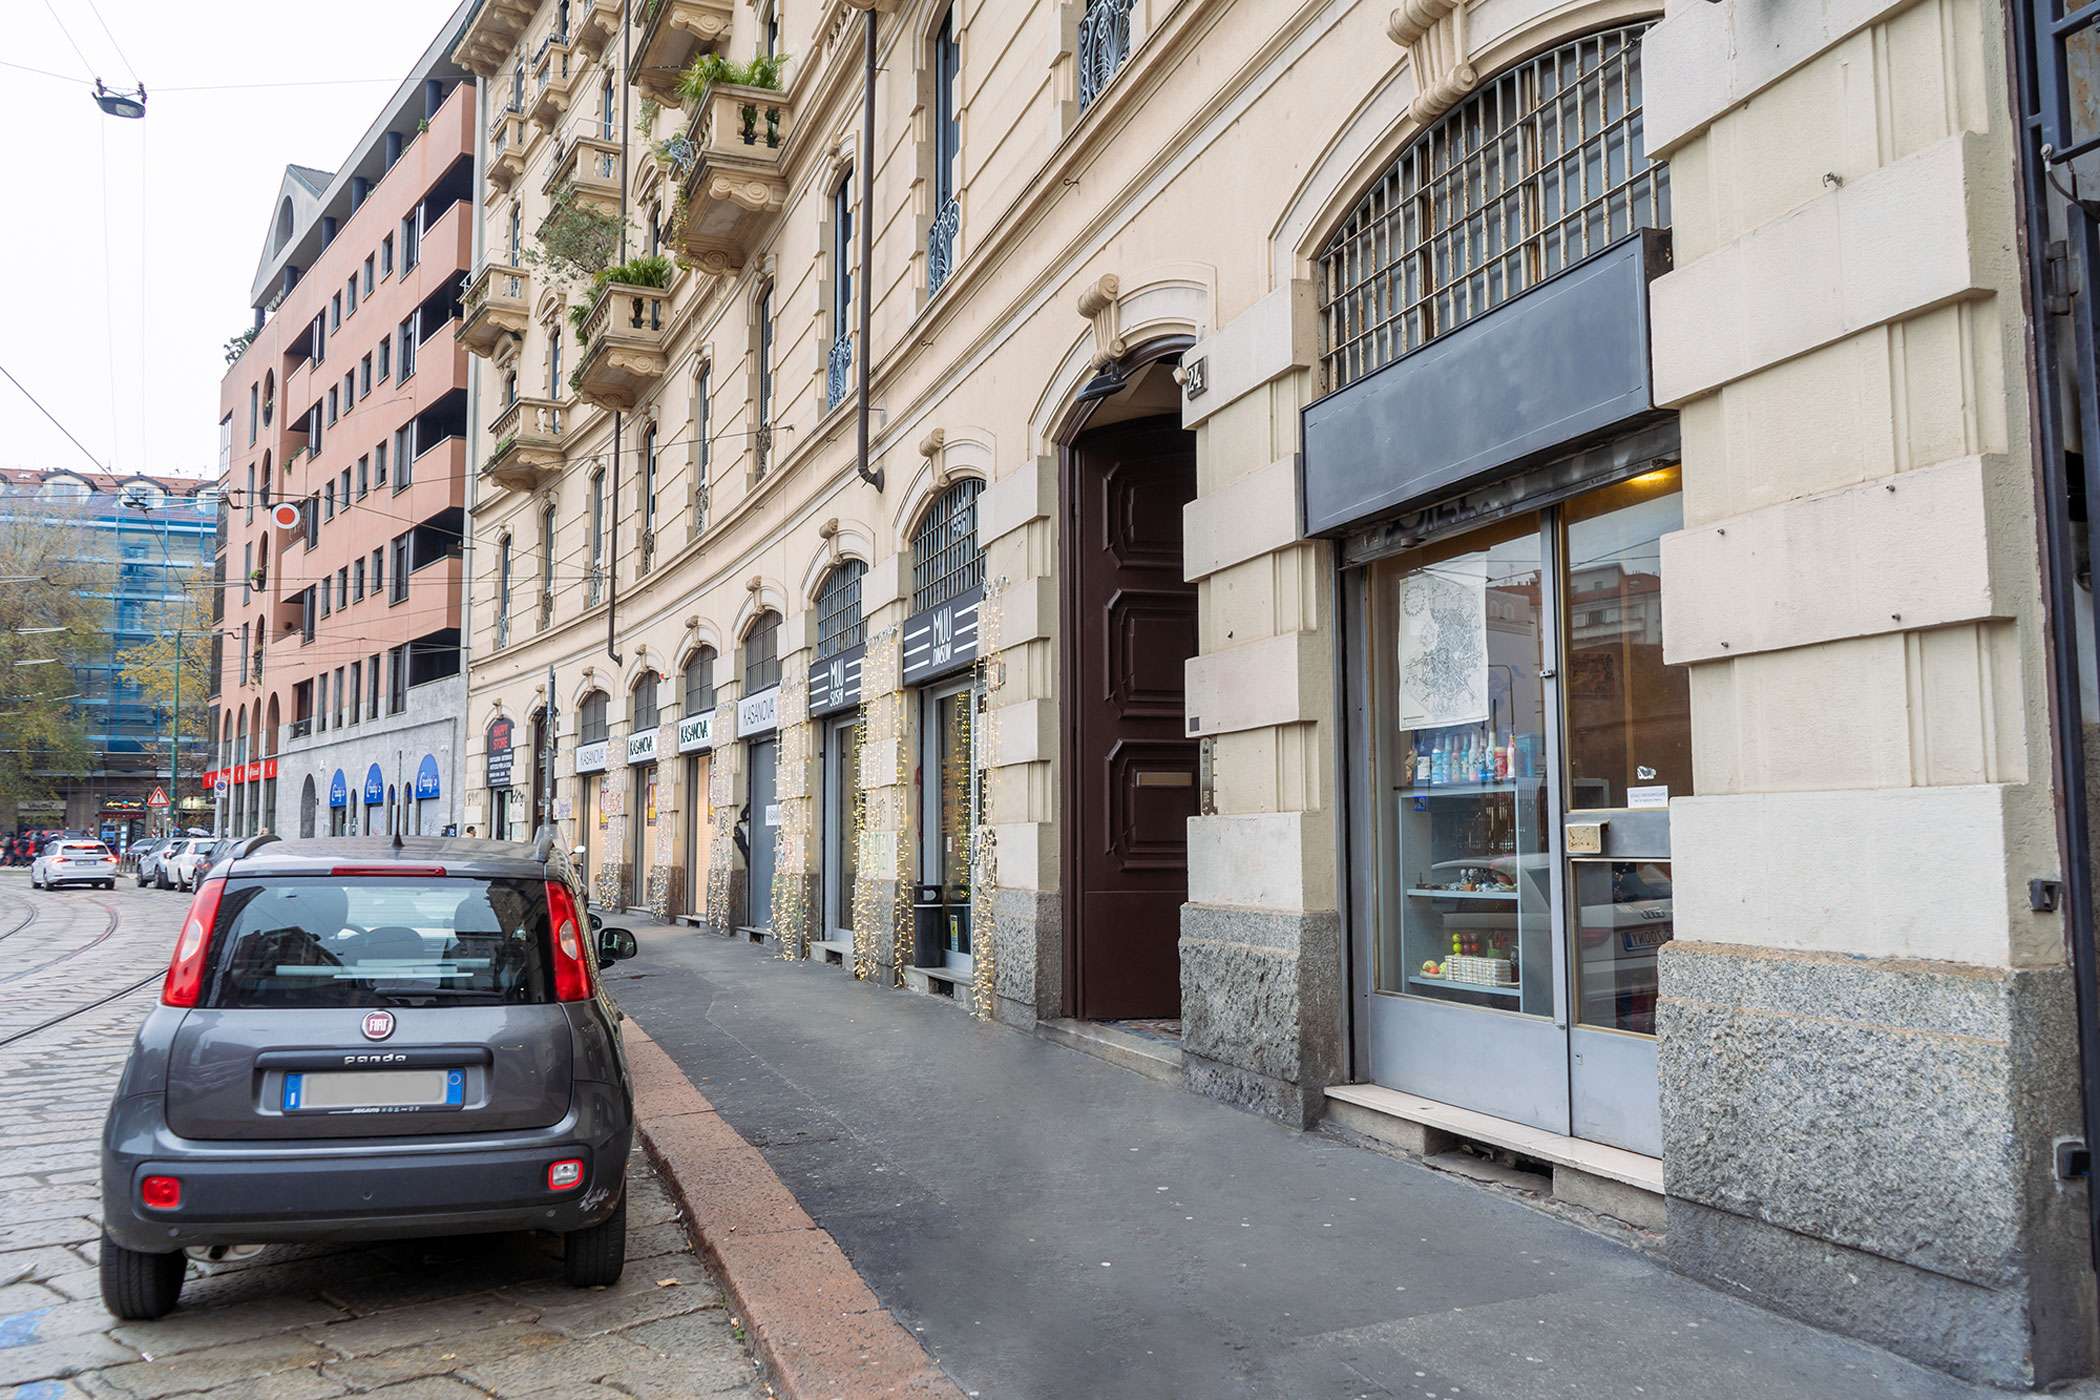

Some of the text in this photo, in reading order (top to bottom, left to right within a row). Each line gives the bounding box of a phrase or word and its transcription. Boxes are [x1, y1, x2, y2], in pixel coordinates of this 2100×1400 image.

[1187, 362, 1202, 392] 24
[933, 605, 952, 647] MUU
[830, 657, 844, 690] MUU
[830, 687, 843, 708] SUSHI
[743, 698, 776, 727] KASANOVA
[493, 723, 509, 737] HAPPY
[680, 719, 708, 744] KASANOVA
[493, 736, 508, 750] STORE
[629, 735, 654, 756] KASANOVA
[580, 748, 605, 766] KASANOVA
[369, 1018, 389, 1032] FIAT
[344, 1053, 407, 1065] panda
